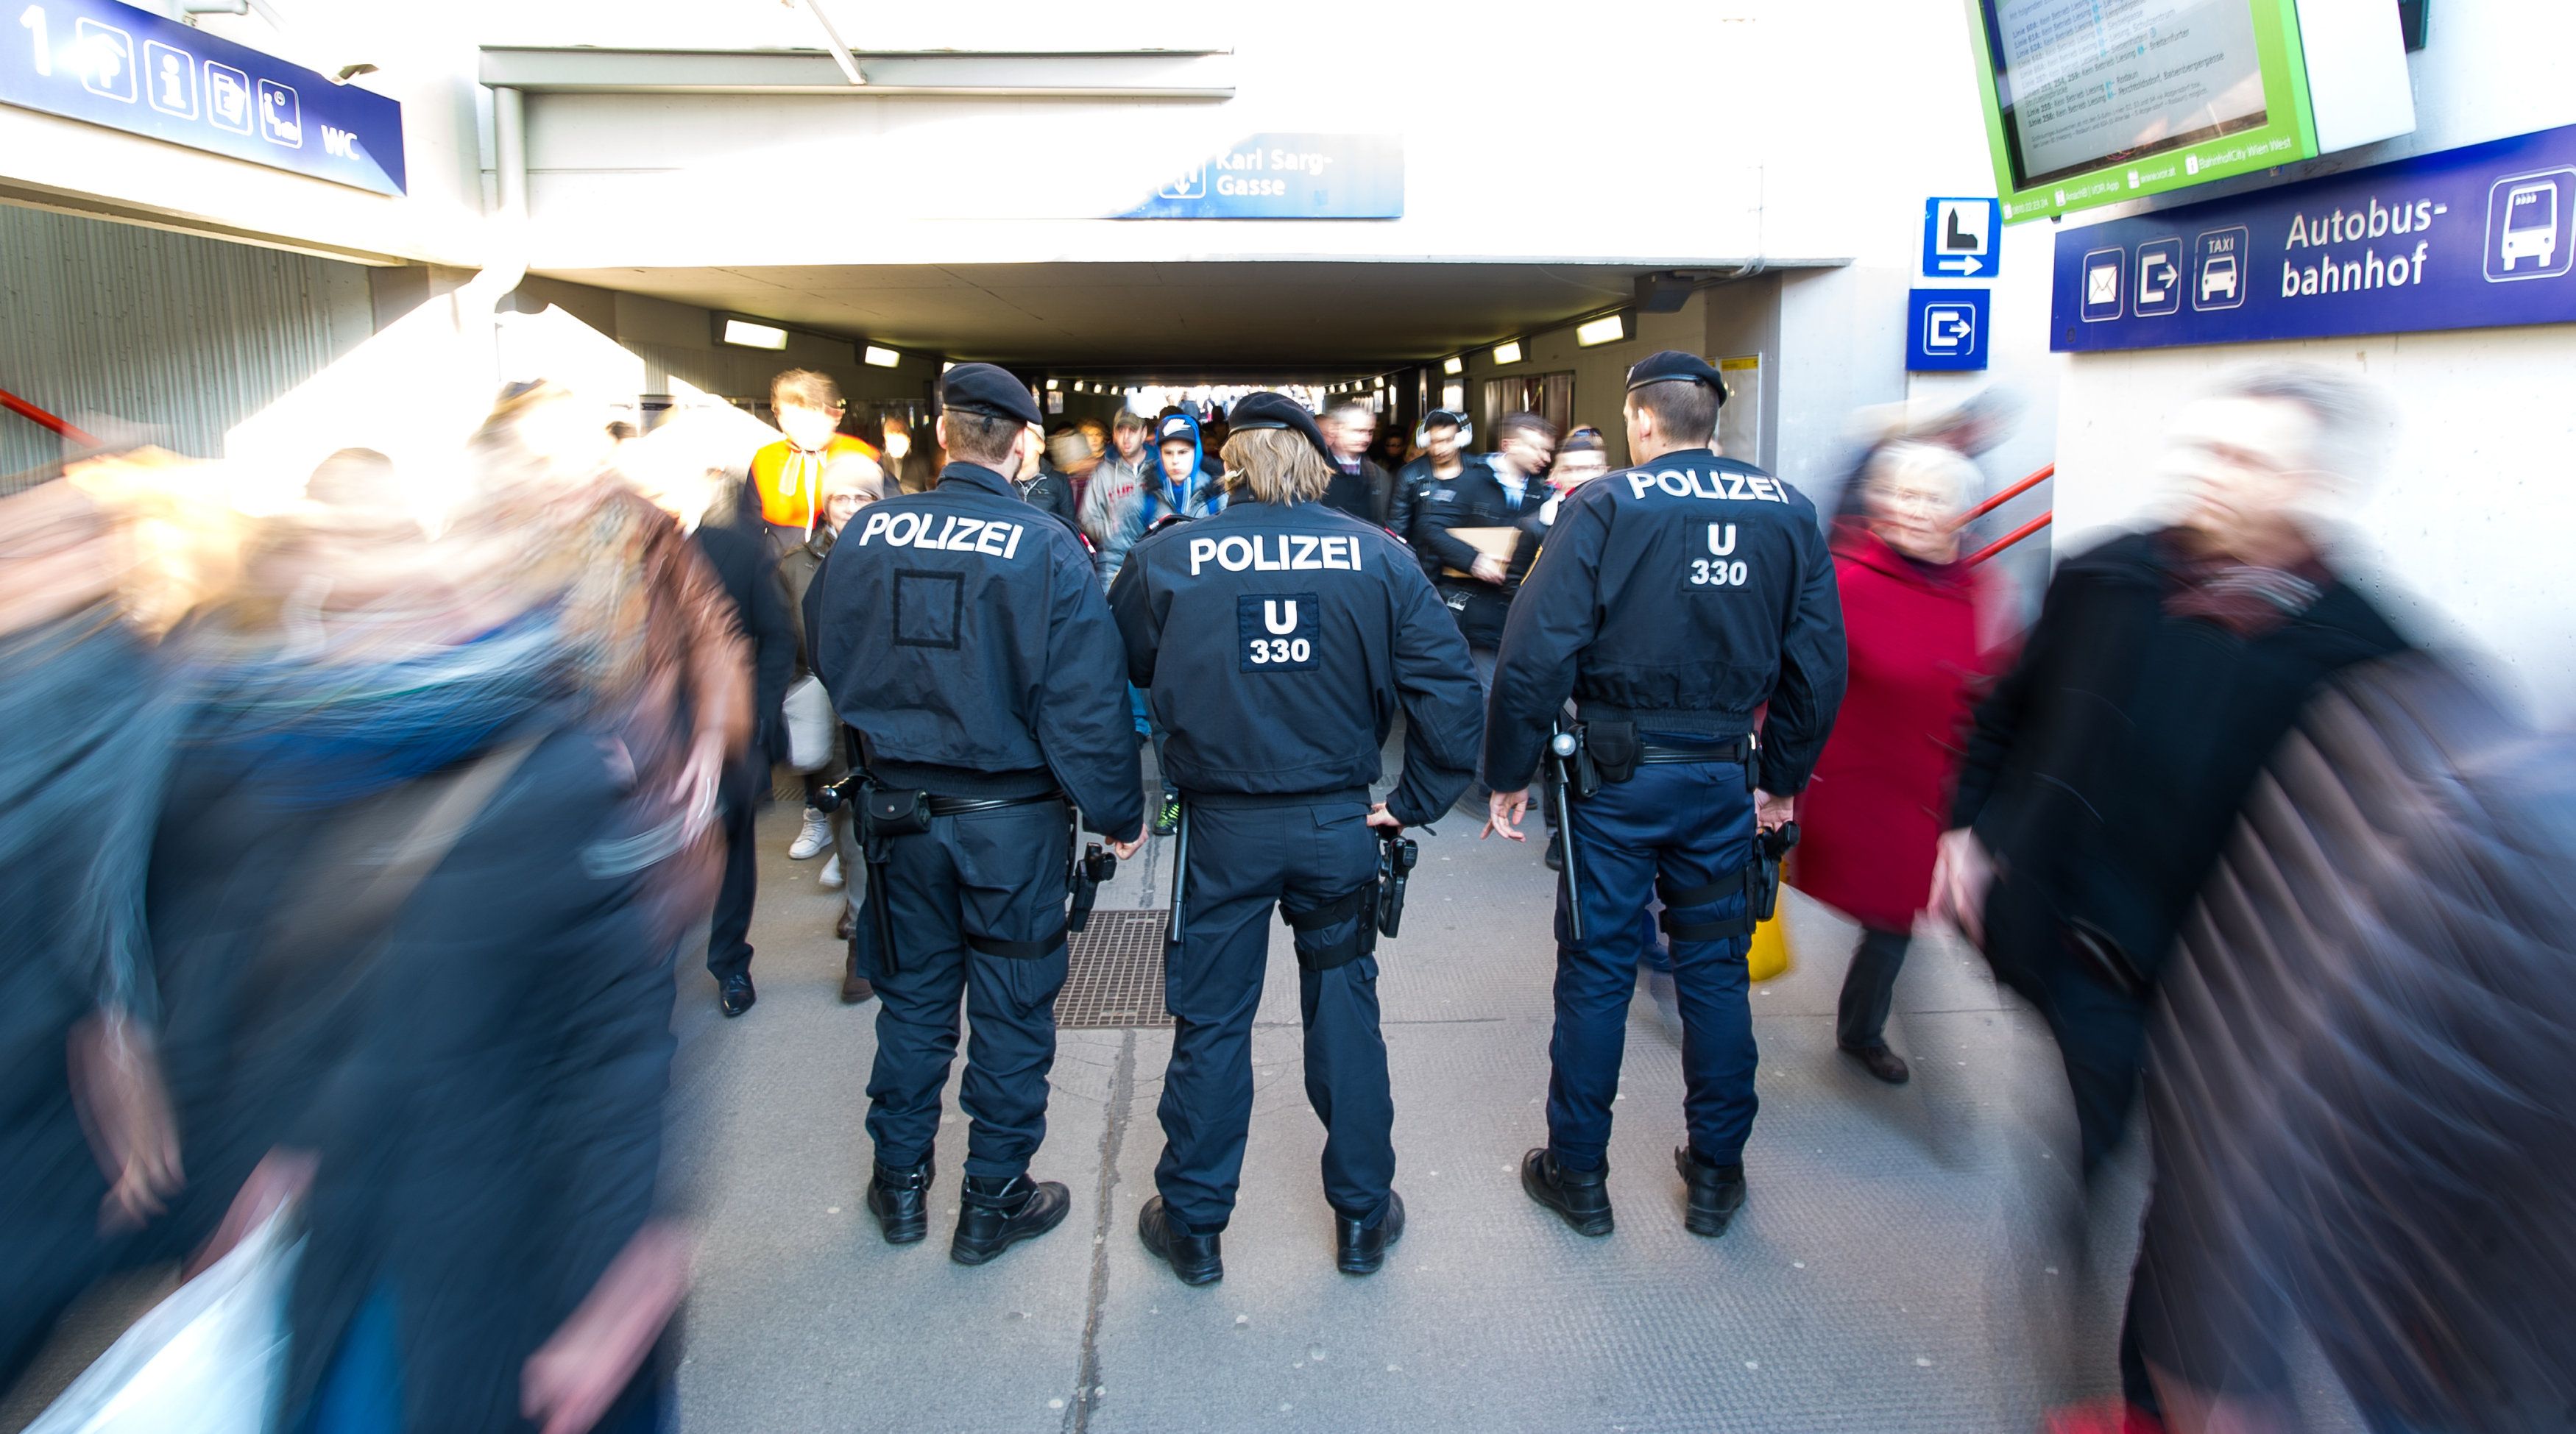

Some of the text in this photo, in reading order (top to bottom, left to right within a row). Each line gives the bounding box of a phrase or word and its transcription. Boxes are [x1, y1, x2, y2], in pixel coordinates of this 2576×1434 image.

[20, 4, 51, 77] 1
[322, 124, 360, 161] WC
[1216, 148, 1334, 176] Karl Sarg-
[1217, 174, 1285, 196] Gasse
[2285, 197, 2447, 249] Autobus-
[2208, 235, 2234, 254] TAXI
[2282, 240, 2427, 298] bahnhof
[1625, 469, 1789, 505] POLIZEI
[859, 512, 1024, 560] POLIZEI
[1708, 522, 1736, 556] U
[1190, 534, 1362, 575] POLIZEI
[1690, 558, 1748, 586] 330
[1264, 600, 1298, 634] U
[1250, 639, 1311, 664] 330
